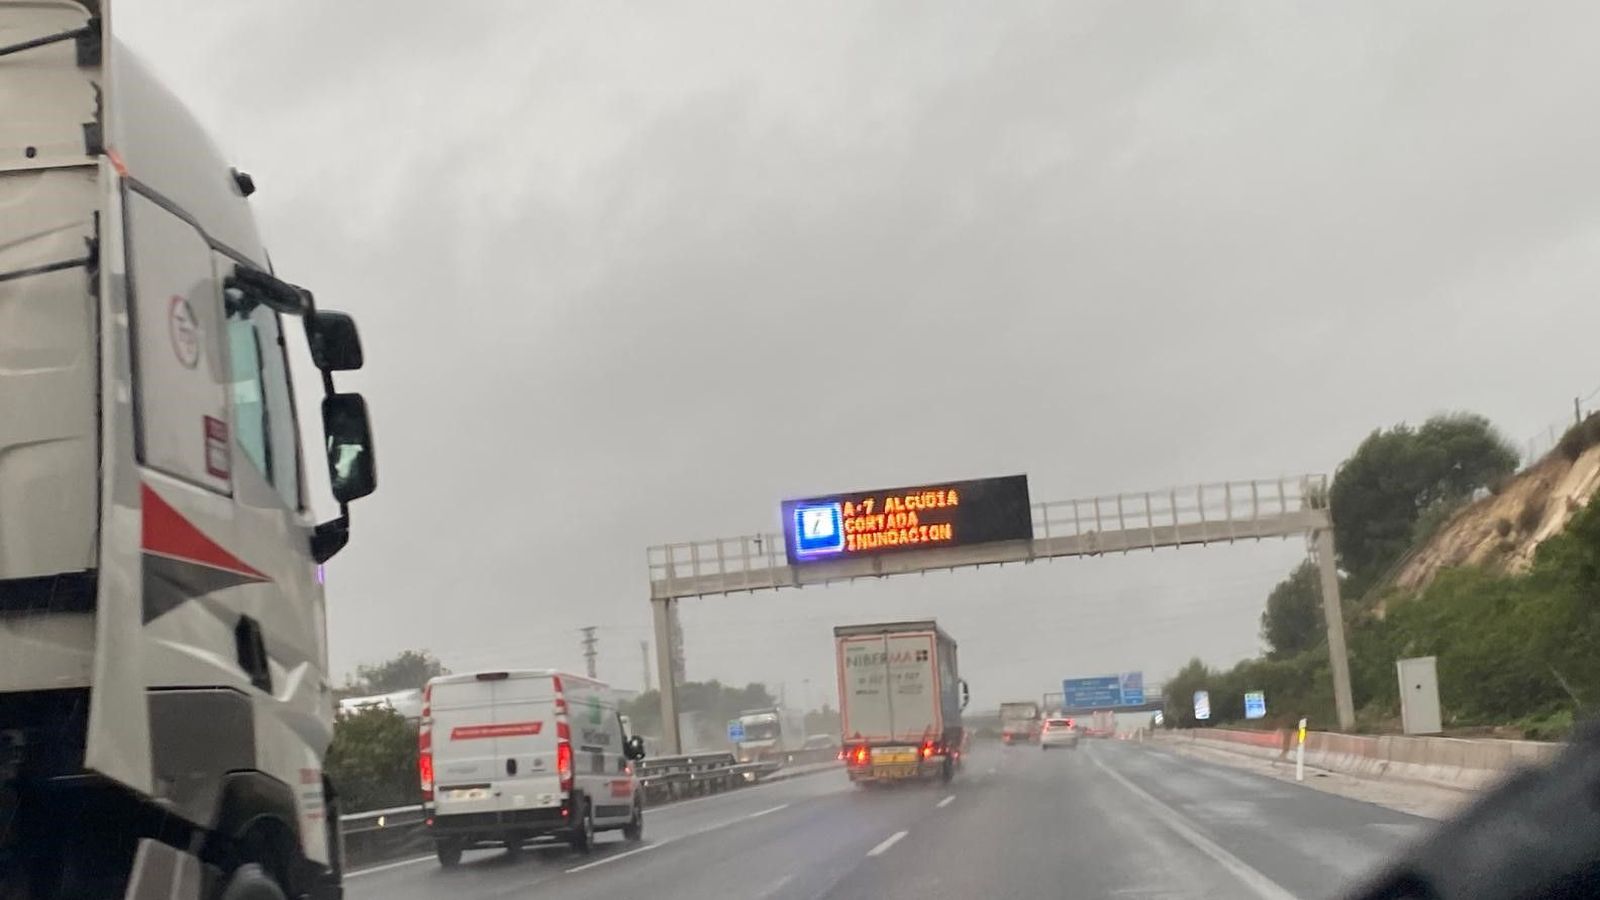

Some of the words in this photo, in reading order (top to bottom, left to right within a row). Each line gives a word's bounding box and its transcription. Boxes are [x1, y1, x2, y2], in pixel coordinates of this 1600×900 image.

[843, 498, 875, 517] A-7
[885, 489, 959, 513] ALCUDIA
[844, 511, 919, 533] CORTADA
[846, 523, 953, 551] INUNDACION
